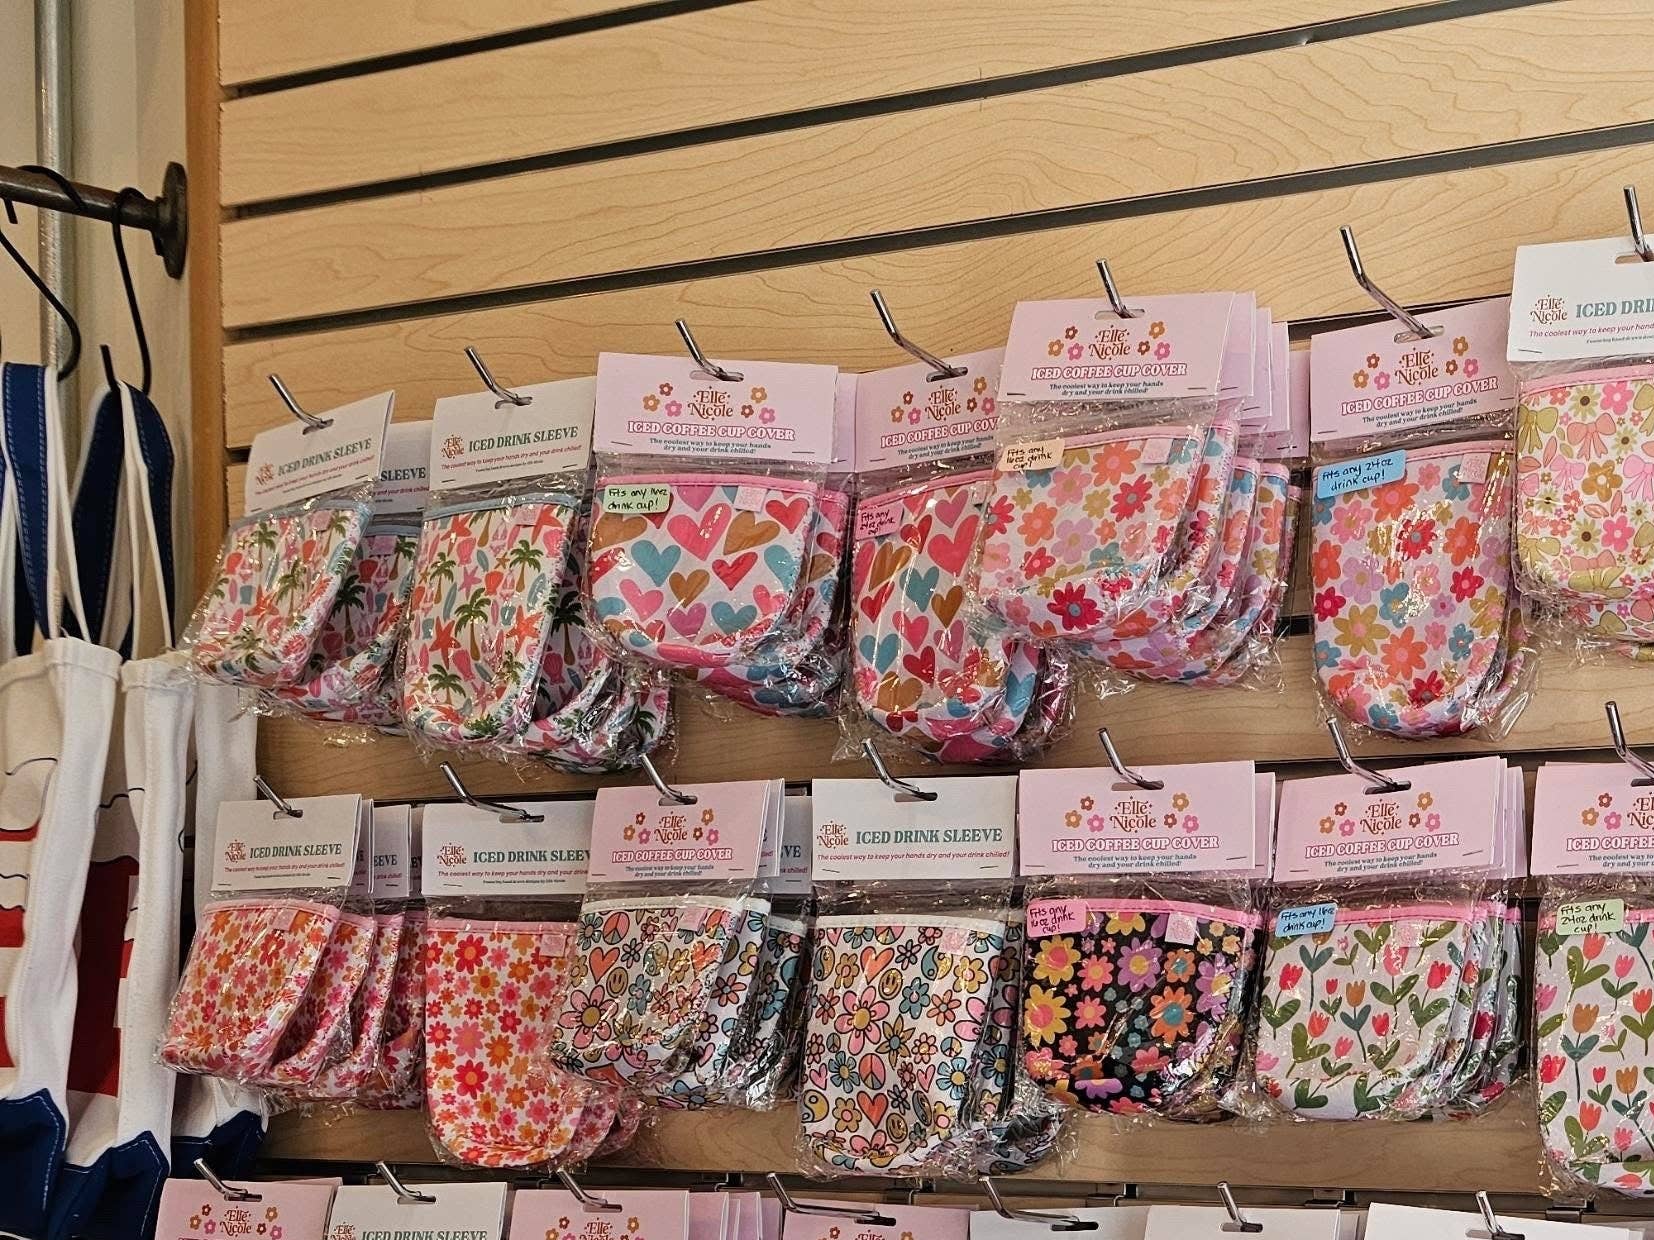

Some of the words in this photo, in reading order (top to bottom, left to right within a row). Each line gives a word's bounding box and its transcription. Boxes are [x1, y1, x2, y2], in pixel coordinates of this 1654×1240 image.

[1538, 298, 1562, 310] Elle
[1576, 302, 1617, 319] ICED
[1530, 308, 1567, 324] Nicole
[1031, 367, 1062, 380] ICED
[1063, 365, 1114, 379] COFFEE
[1114, 365, 1140, 378] CUP
[1141, 363, 1188, 376] COVER
[628, 421, 660, 433] ICED
[661, 422, 716, 437] COFFEE
[717, 426, 745, 438] CUP
[747, 426, 795, 441] COVER
[278, 460, 301, 476] ICED
[302, 451, 332, 470] DRINK
[333, 439, 371, 462] SLEEVE
[856, 831, 890, 845] ICED
[894, 830, 940, 844] DRINK
[943, 828, 1003, 843] SLEEVE
[1051, 839, 1084, 852] ICED
[1085, 838, 1141, 852] COFFEE
[1141, 838, 1171, 851] CUP
[1172, 836, 1219, 850] COVER
[1567, 837, 1600, 852] ICED
[250, 847, 270, 859] ICED
[272, 845, 301, 858] DRINK
[303, 843, 342, 857] SLEEVE
